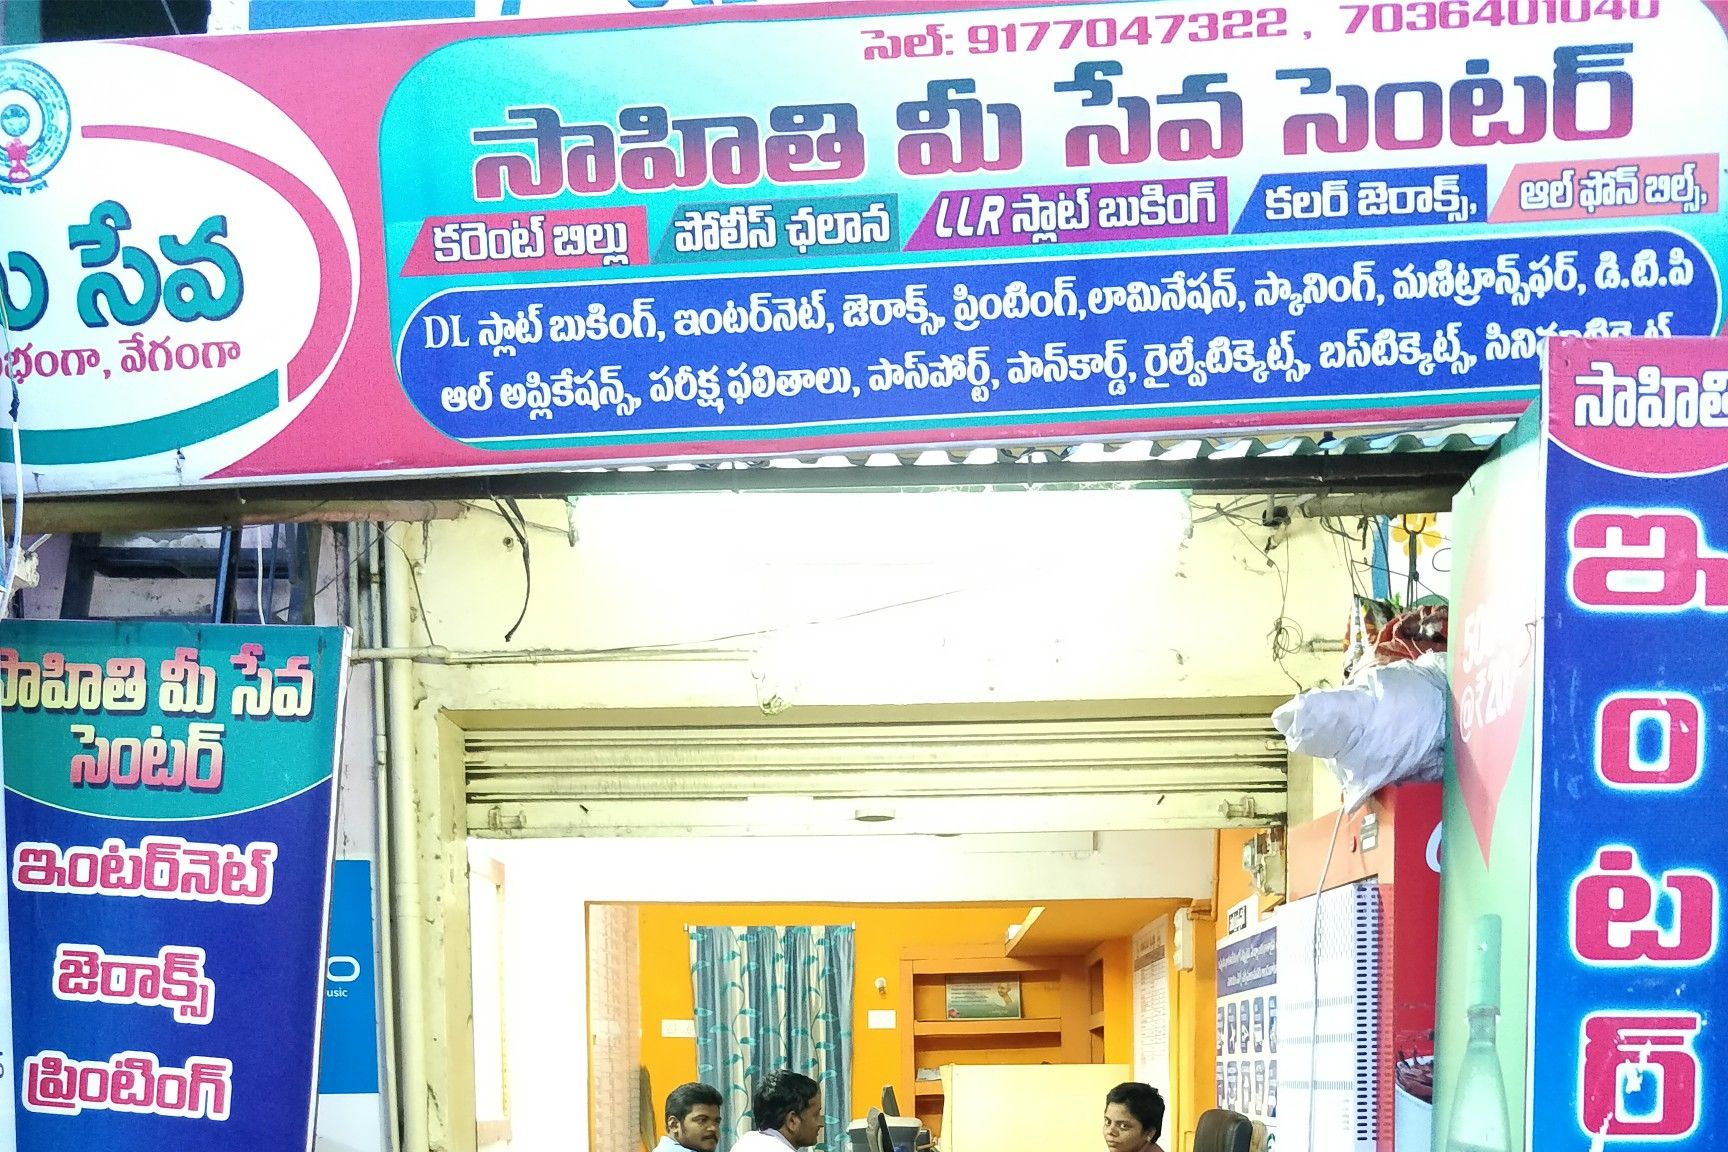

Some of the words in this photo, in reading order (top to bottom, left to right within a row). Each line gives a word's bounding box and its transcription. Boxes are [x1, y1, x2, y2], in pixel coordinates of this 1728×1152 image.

[967, 8, 1288, 53] 9177047322
[1344, 0, 1660, 35] 7036401040
[473, 103, 866, 199] సాహితి
[896, 77, 1022, 175] మీ
[1054, 60, 1244, 168] సేవ
[1275, 42, 1634, 156] సెంటర్
[432, 213, 546, 263] కరెంట్
[553, 217, 629, 265] బిల్లు
[673, 204, 777, 254] పోలీస్
[935, 195, 1005, 237] LLR
[1011, 187, 1091, 244] స్లాట్
[1098, 181, 1217, 229] బుకింగ్
[1264, 179, 1349, 220] కలర్
[1519, 168, 1575, 211] ఆల్
[1579, 164, 1641, 214] ఫోన్
[68, 200, 244, 328] సేవ
[118, 332, 241, 373] వేగంగా
[423, 314, 470, 349] DL
[477, 303, 543, 358] స్లాట్
[440, 371, 493, 412] ఆల్
[649, 366, 724, 415] పరీక్ష
[158, 647, 216, 714] మీ
[230, 643, 314, 717] సేవ
[69, 722, 226, 791] సెంటర్
[56, 947, 213, 1020] జెరాక్స్
[326, 987, 349, 998] usic
[26, 1055, 229, 1116] ప్రింటింగ్
